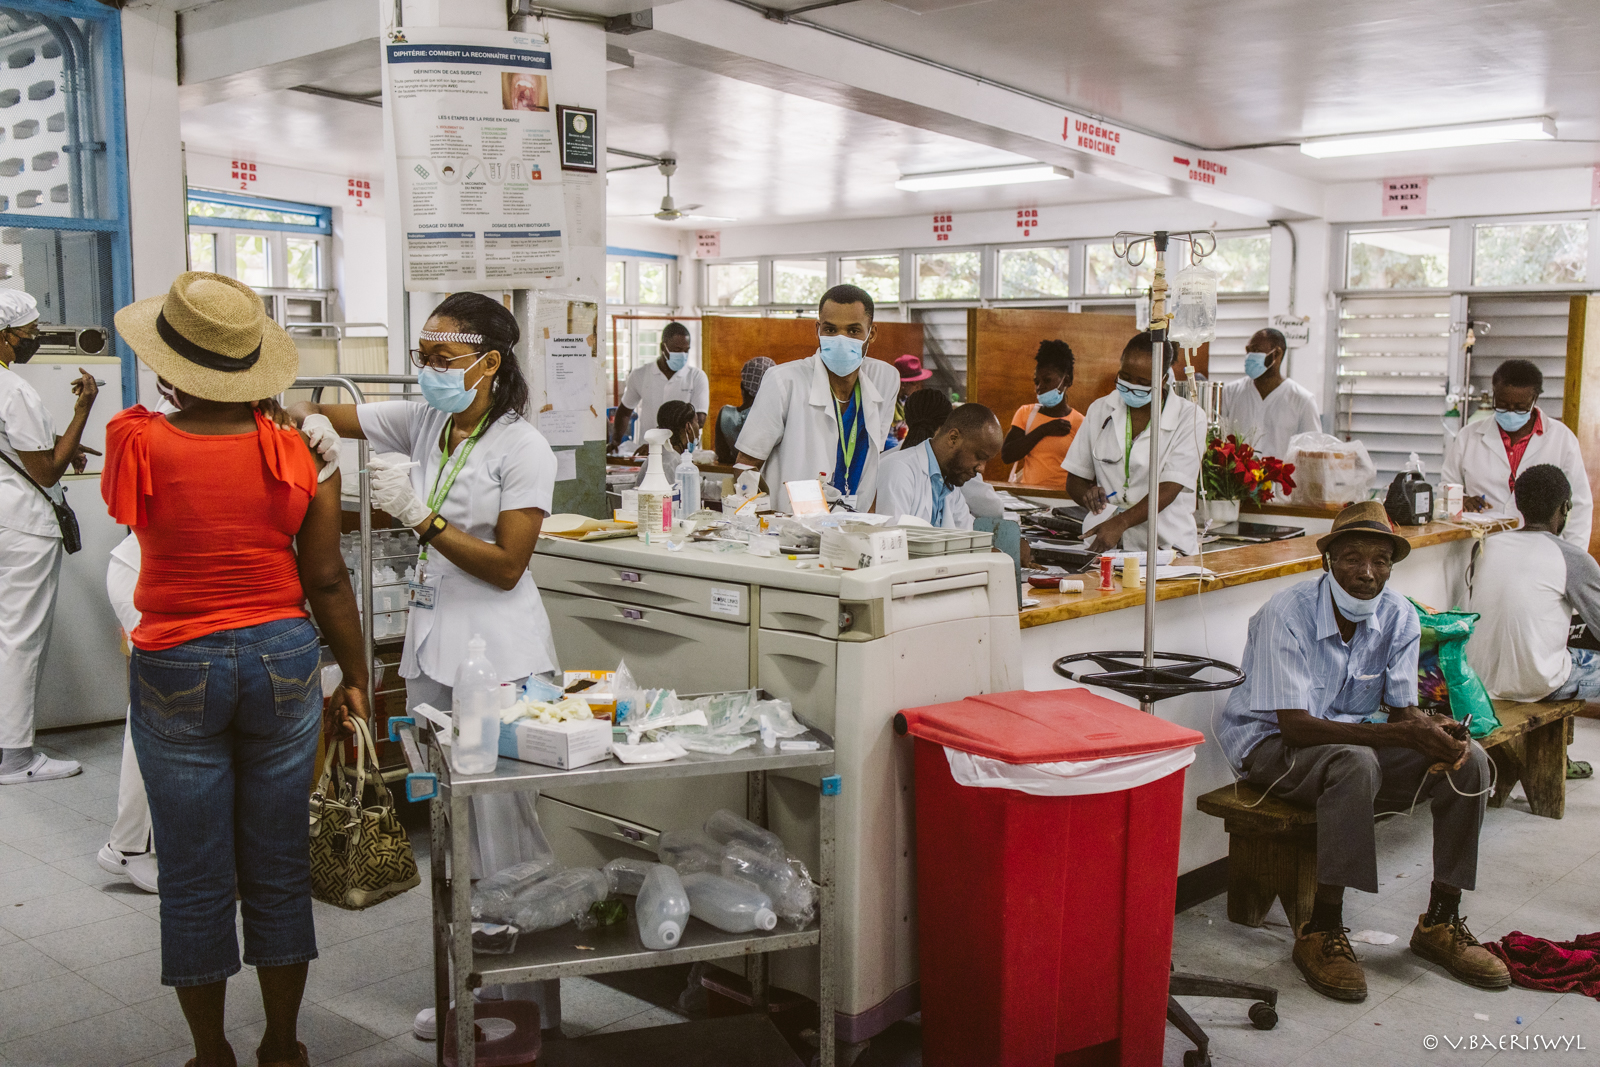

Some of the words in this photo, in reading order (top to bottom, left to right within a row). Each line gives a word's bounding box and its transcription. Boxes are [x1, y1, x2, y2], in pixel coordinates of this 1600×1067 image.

[393, 49, 428, 57] DIPHTÉRIE:
[521, 56, 546, 64] REPONDRE
[1075, 120, 1120, 143] URGENCE
[1078, 136, 1116, 156] MEDICINE
[232, 160, 257, 171] SOB
[1198, 158, 1227, 175] MEDICINE
[232, 171, 257, 181] MED
[1189, 170, 1215, 184] OBSERV
[240, 182, 247, 190] 2
[348, 179, 370, 189] SOB
[933, 215, 952, 223] SOB
[1016, 209, 1038, 218] SOB
